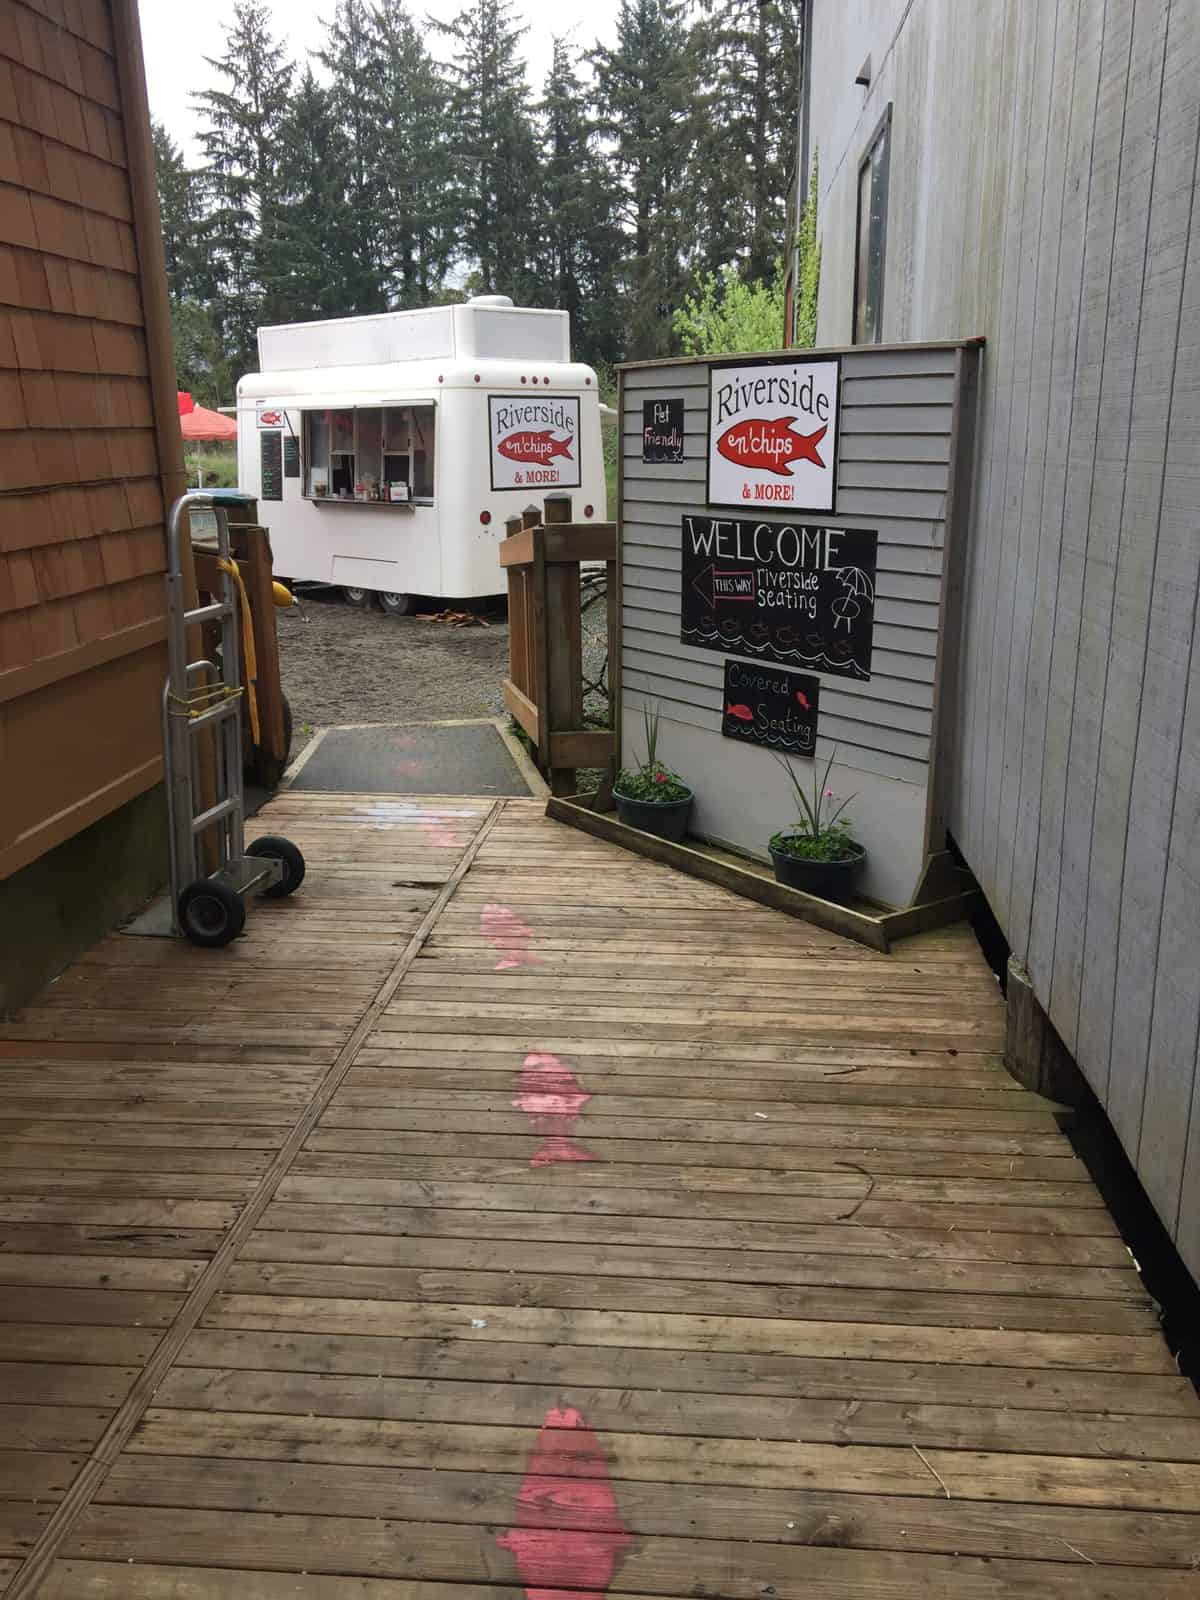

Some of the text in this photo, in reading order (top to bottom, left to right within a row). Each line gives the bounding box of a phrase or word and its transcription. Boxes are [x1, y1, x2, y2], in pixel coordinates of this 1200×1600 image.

[715, 368, 830, 426] Riverside
[496, 402, 575, 435] Riverside
[653, 403, 670, 424] Pet
[644, 426, 682, 453] Friendly
[514, 469, 560, 484] & MORE!
[742, 483, 795, 501] & MORE!
[685, 518, 846, 572] WELCOME
[714, 578, 752, 592] THIS WAY
[757, 567, 820, 591] riverside
[757, 589, 817, 619] seating
[729, 663, 791, 696] Covered
[757, 703, 811, 745] Seating
